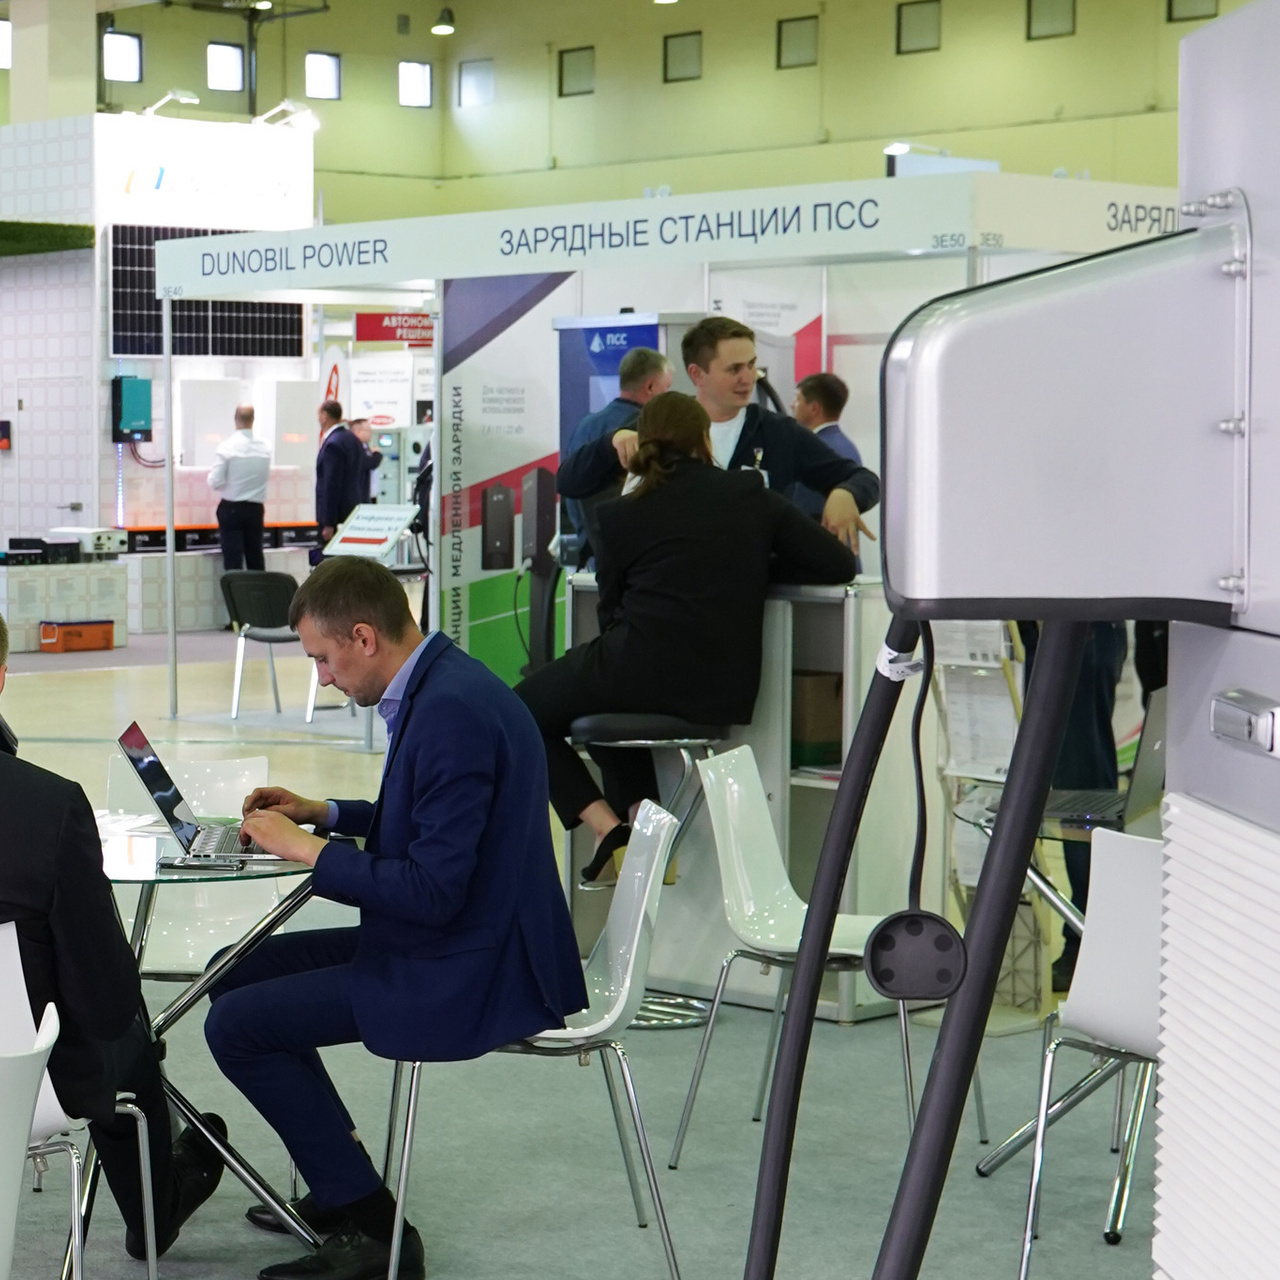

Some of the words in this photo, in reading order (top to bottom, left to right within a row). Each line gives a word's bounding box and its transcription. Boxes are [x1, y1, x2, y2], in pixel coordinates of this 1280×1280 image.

[500, 218, 650, 257] ЗАРЯДНЫЕ
[659, 204, 802, 244] СТАНЦИИ
[812, 199, 880, 232] ПСС
[931, 233, 967, 249] 3E50
[201, 246, 297, 276] DUNOBIL
[303, 238, 389, 269] POWER
[162, 286, 183, 298] 3E40
[451, 385, 463, 466] ЗАРЯДКИ
[451, 470, 463, 578] МЕДЛЕННОЙ
